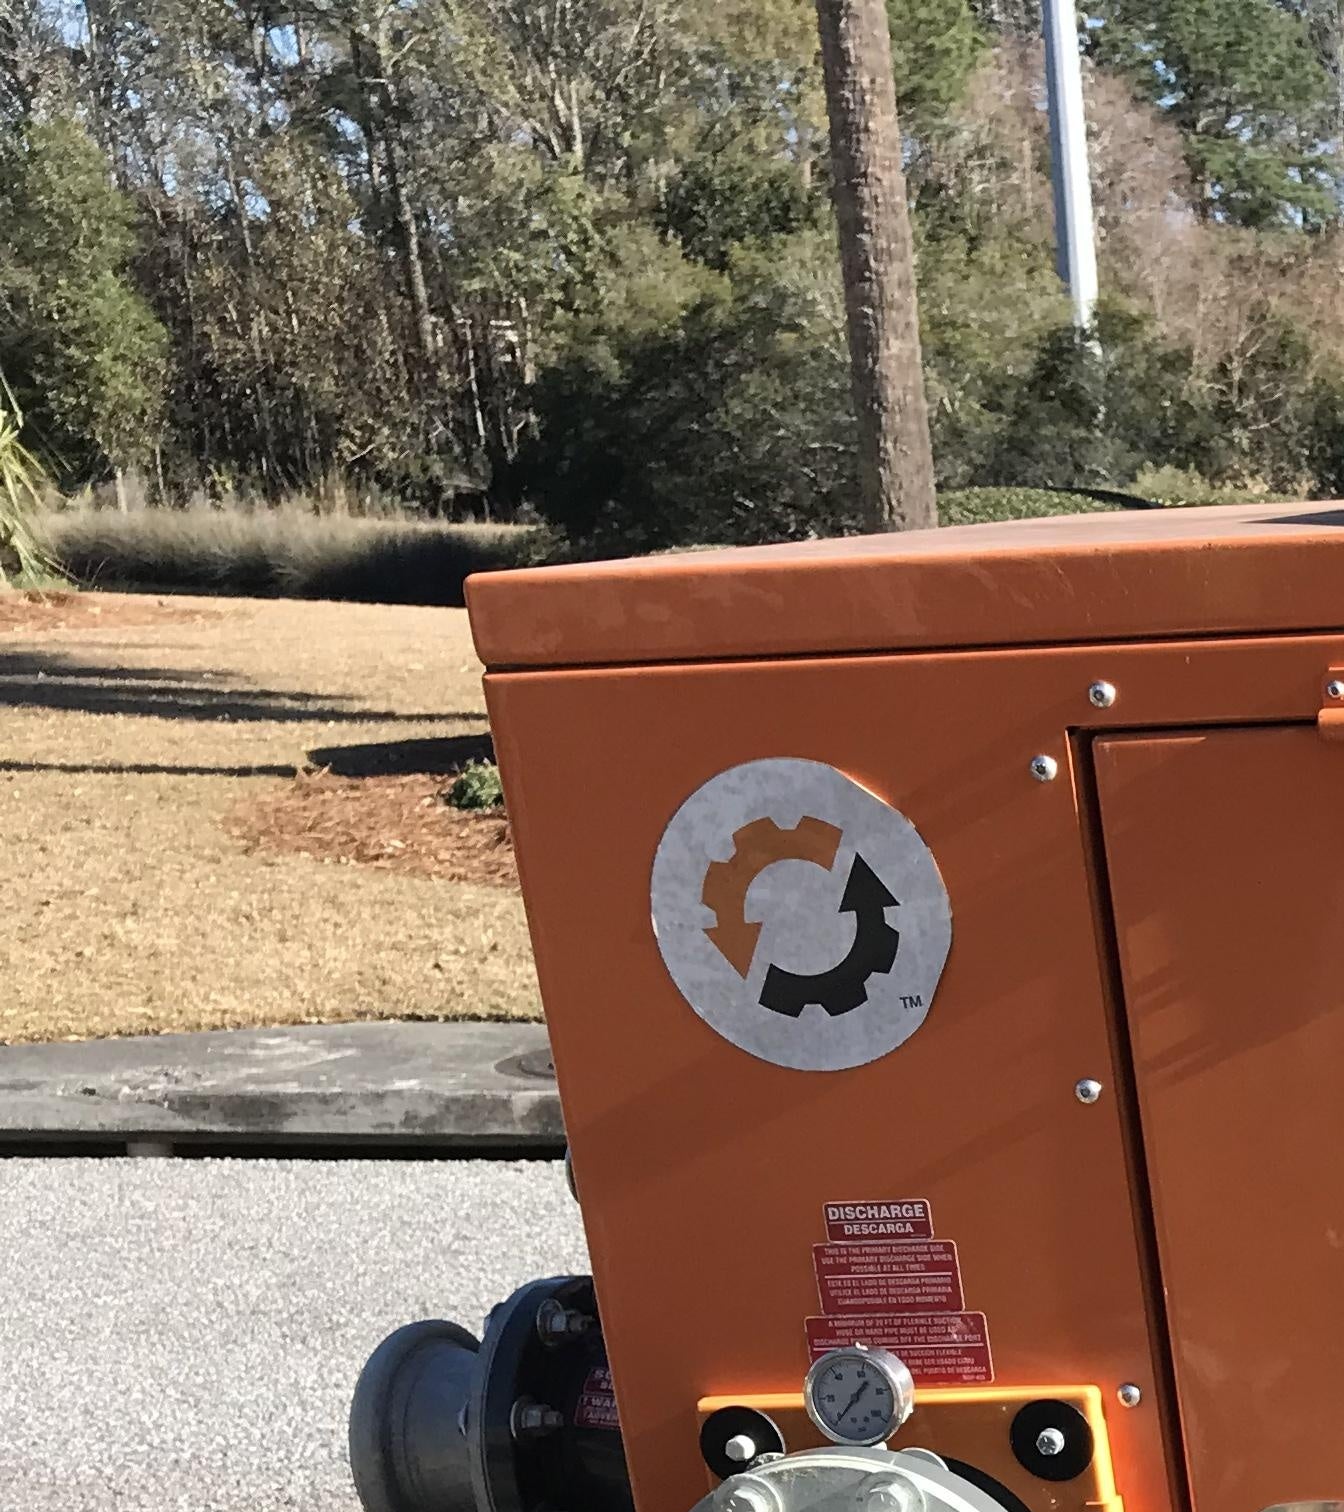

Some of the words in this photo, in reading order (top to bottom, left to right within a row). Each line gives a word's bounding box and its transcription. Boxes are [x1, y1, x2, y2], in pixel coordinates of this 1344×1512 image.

[900, 995, 923, 1010] TM
[828, 1204, 925, 1220] DISCHARGE
[844, 1222, 914, 1236] DESCARGA
